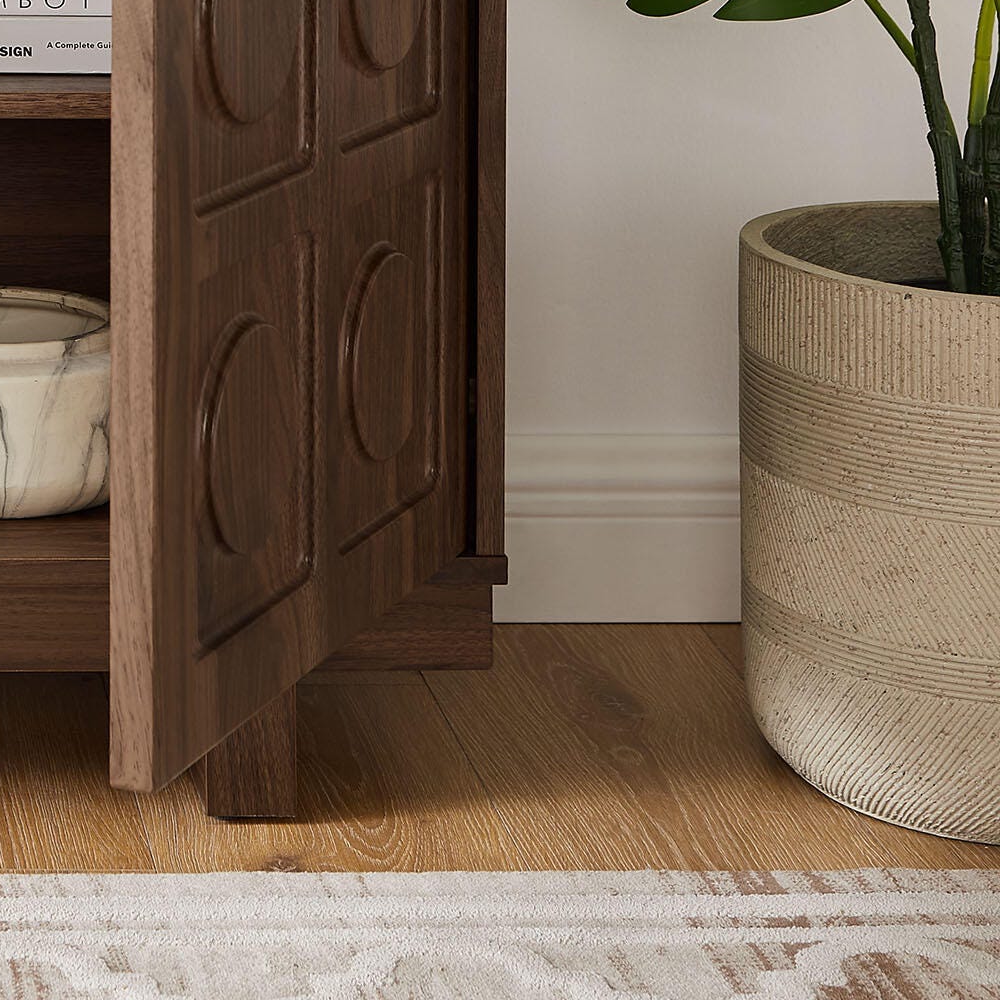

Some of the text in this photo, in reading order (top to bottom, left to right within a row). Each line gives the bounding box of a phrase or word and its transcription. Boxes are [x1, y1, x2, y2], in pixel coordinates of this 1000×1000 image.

[46, 41, 112, 51] A Complete Gui
